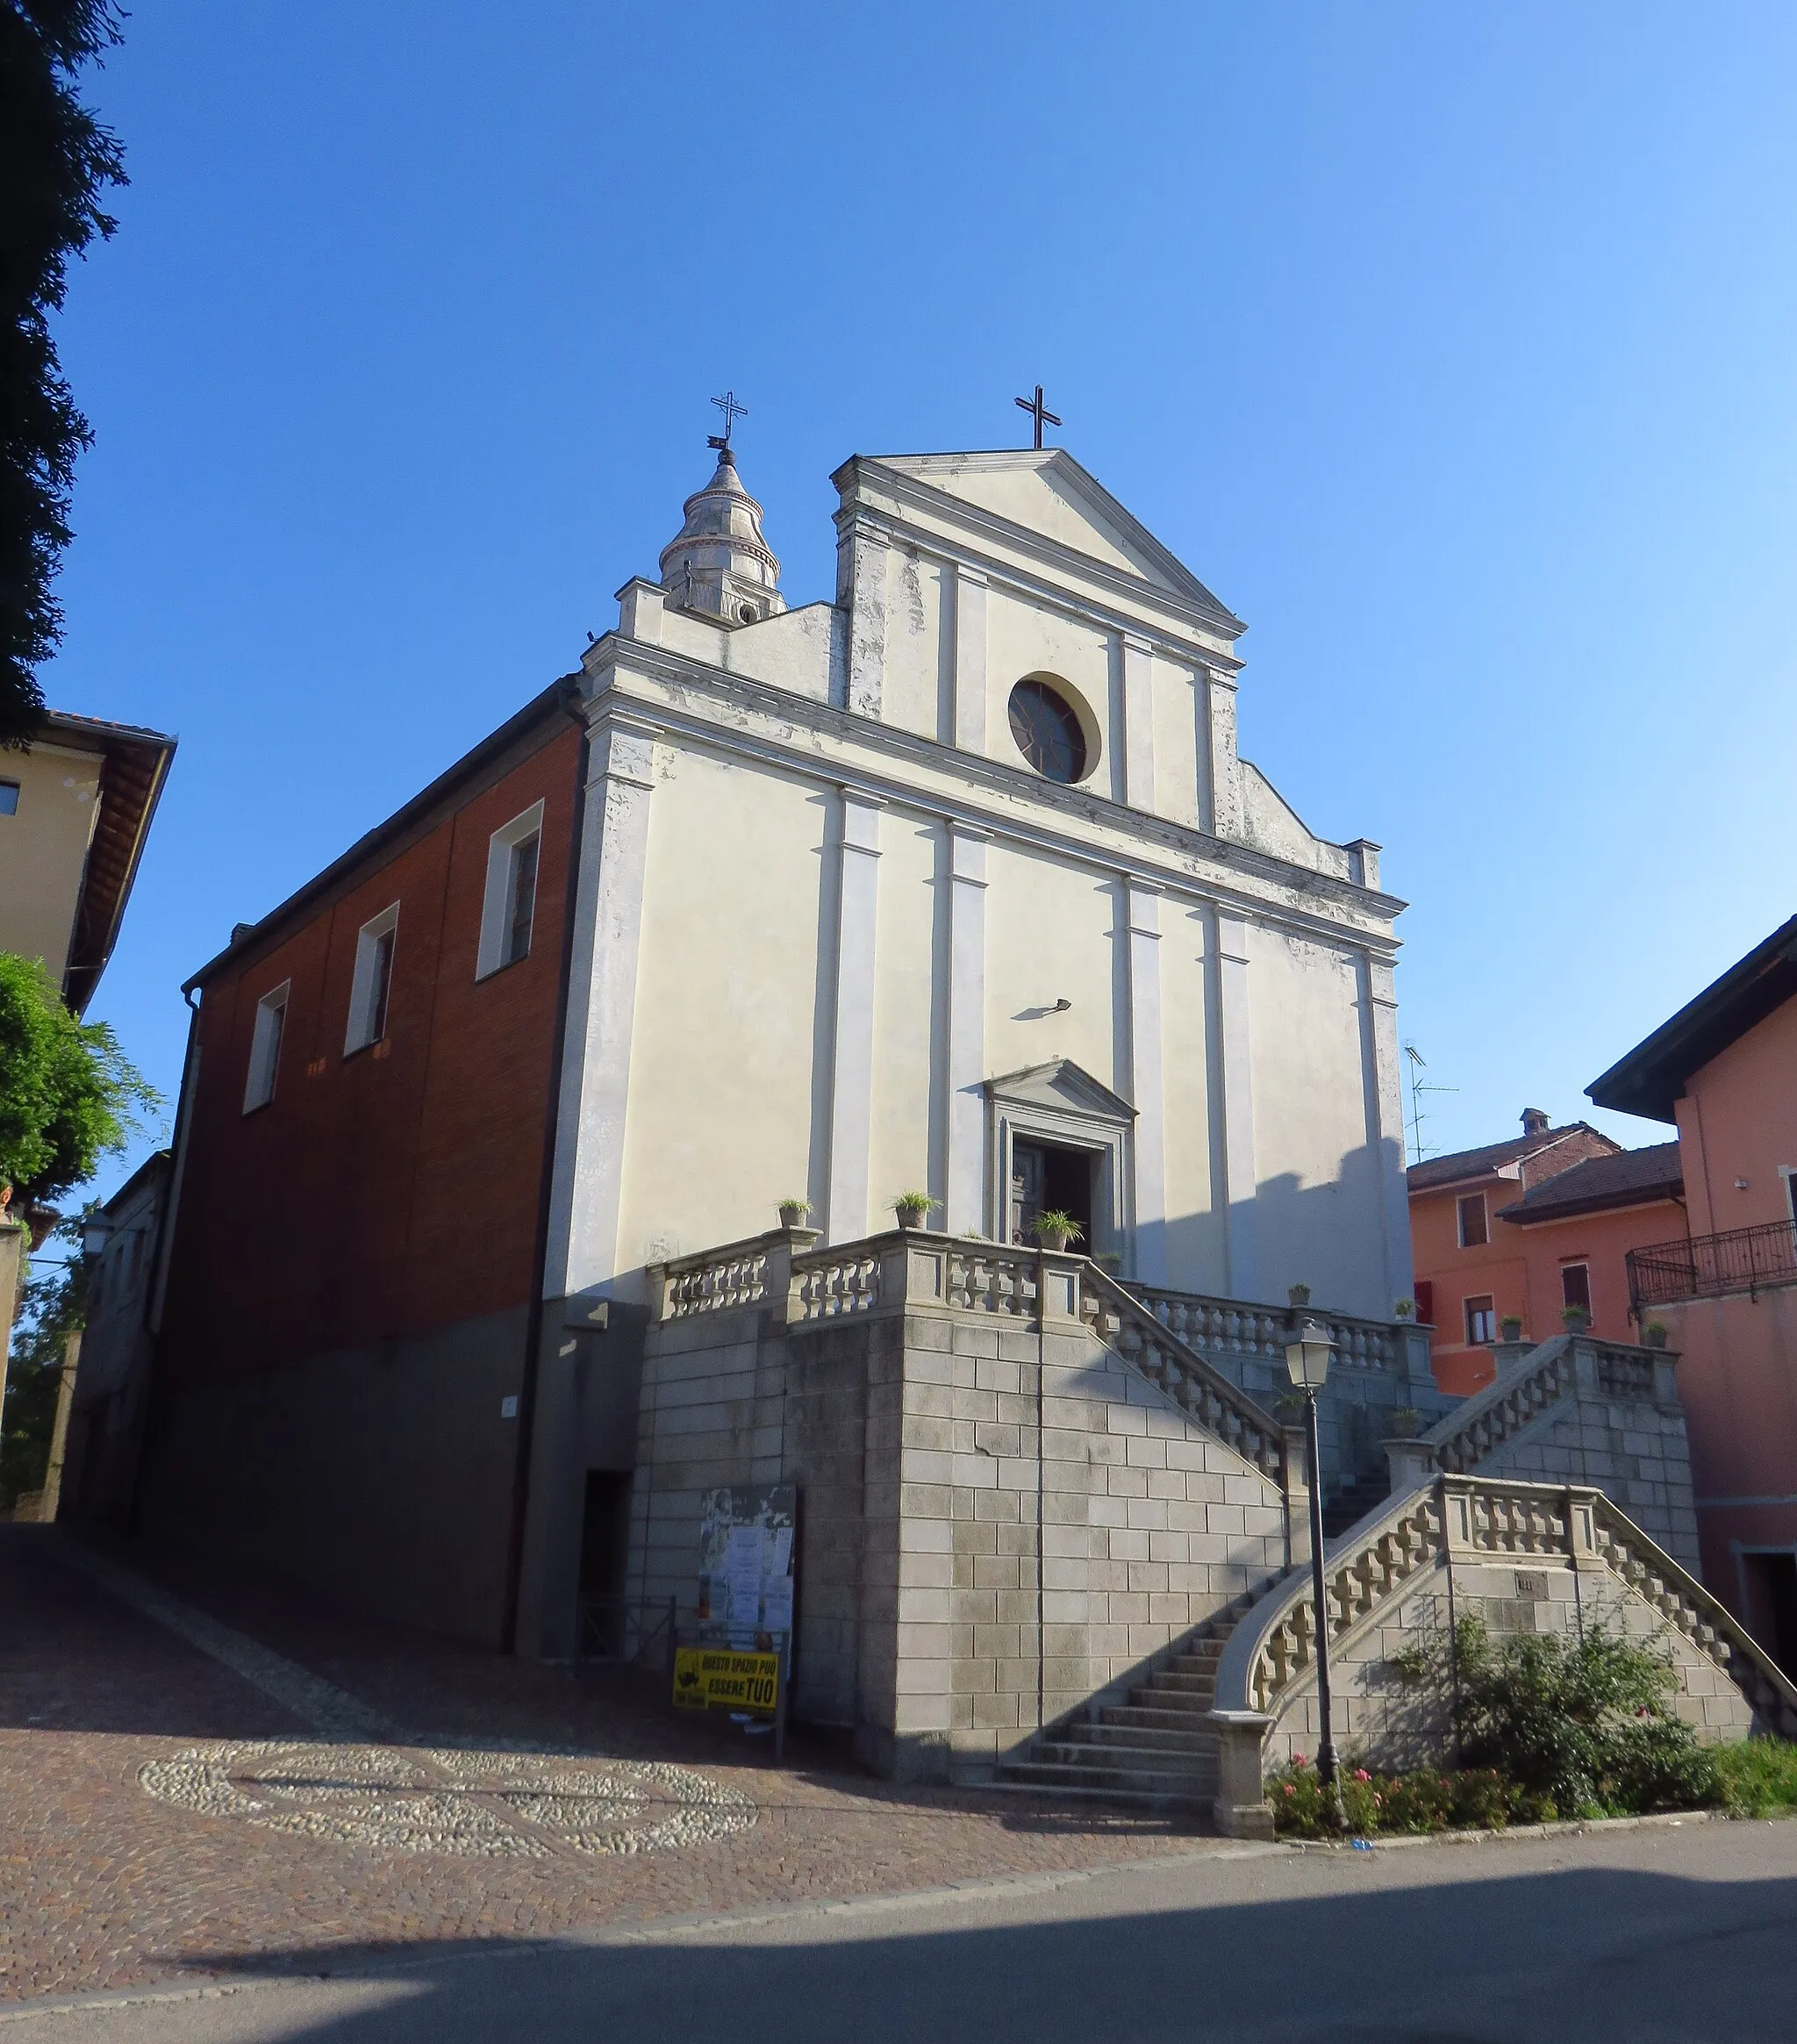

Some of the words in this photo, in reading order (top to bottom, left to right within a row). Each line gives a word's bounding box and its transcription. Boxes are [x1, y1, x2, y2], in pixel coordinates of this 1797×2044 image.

[702, 1655, 730, 1672] QUESTO
[732, 1658, 757, 1675] SPAZIO
[709, 1679, 744, 1696] ESSERE
[746, 1678, 774, 1704] TUO
